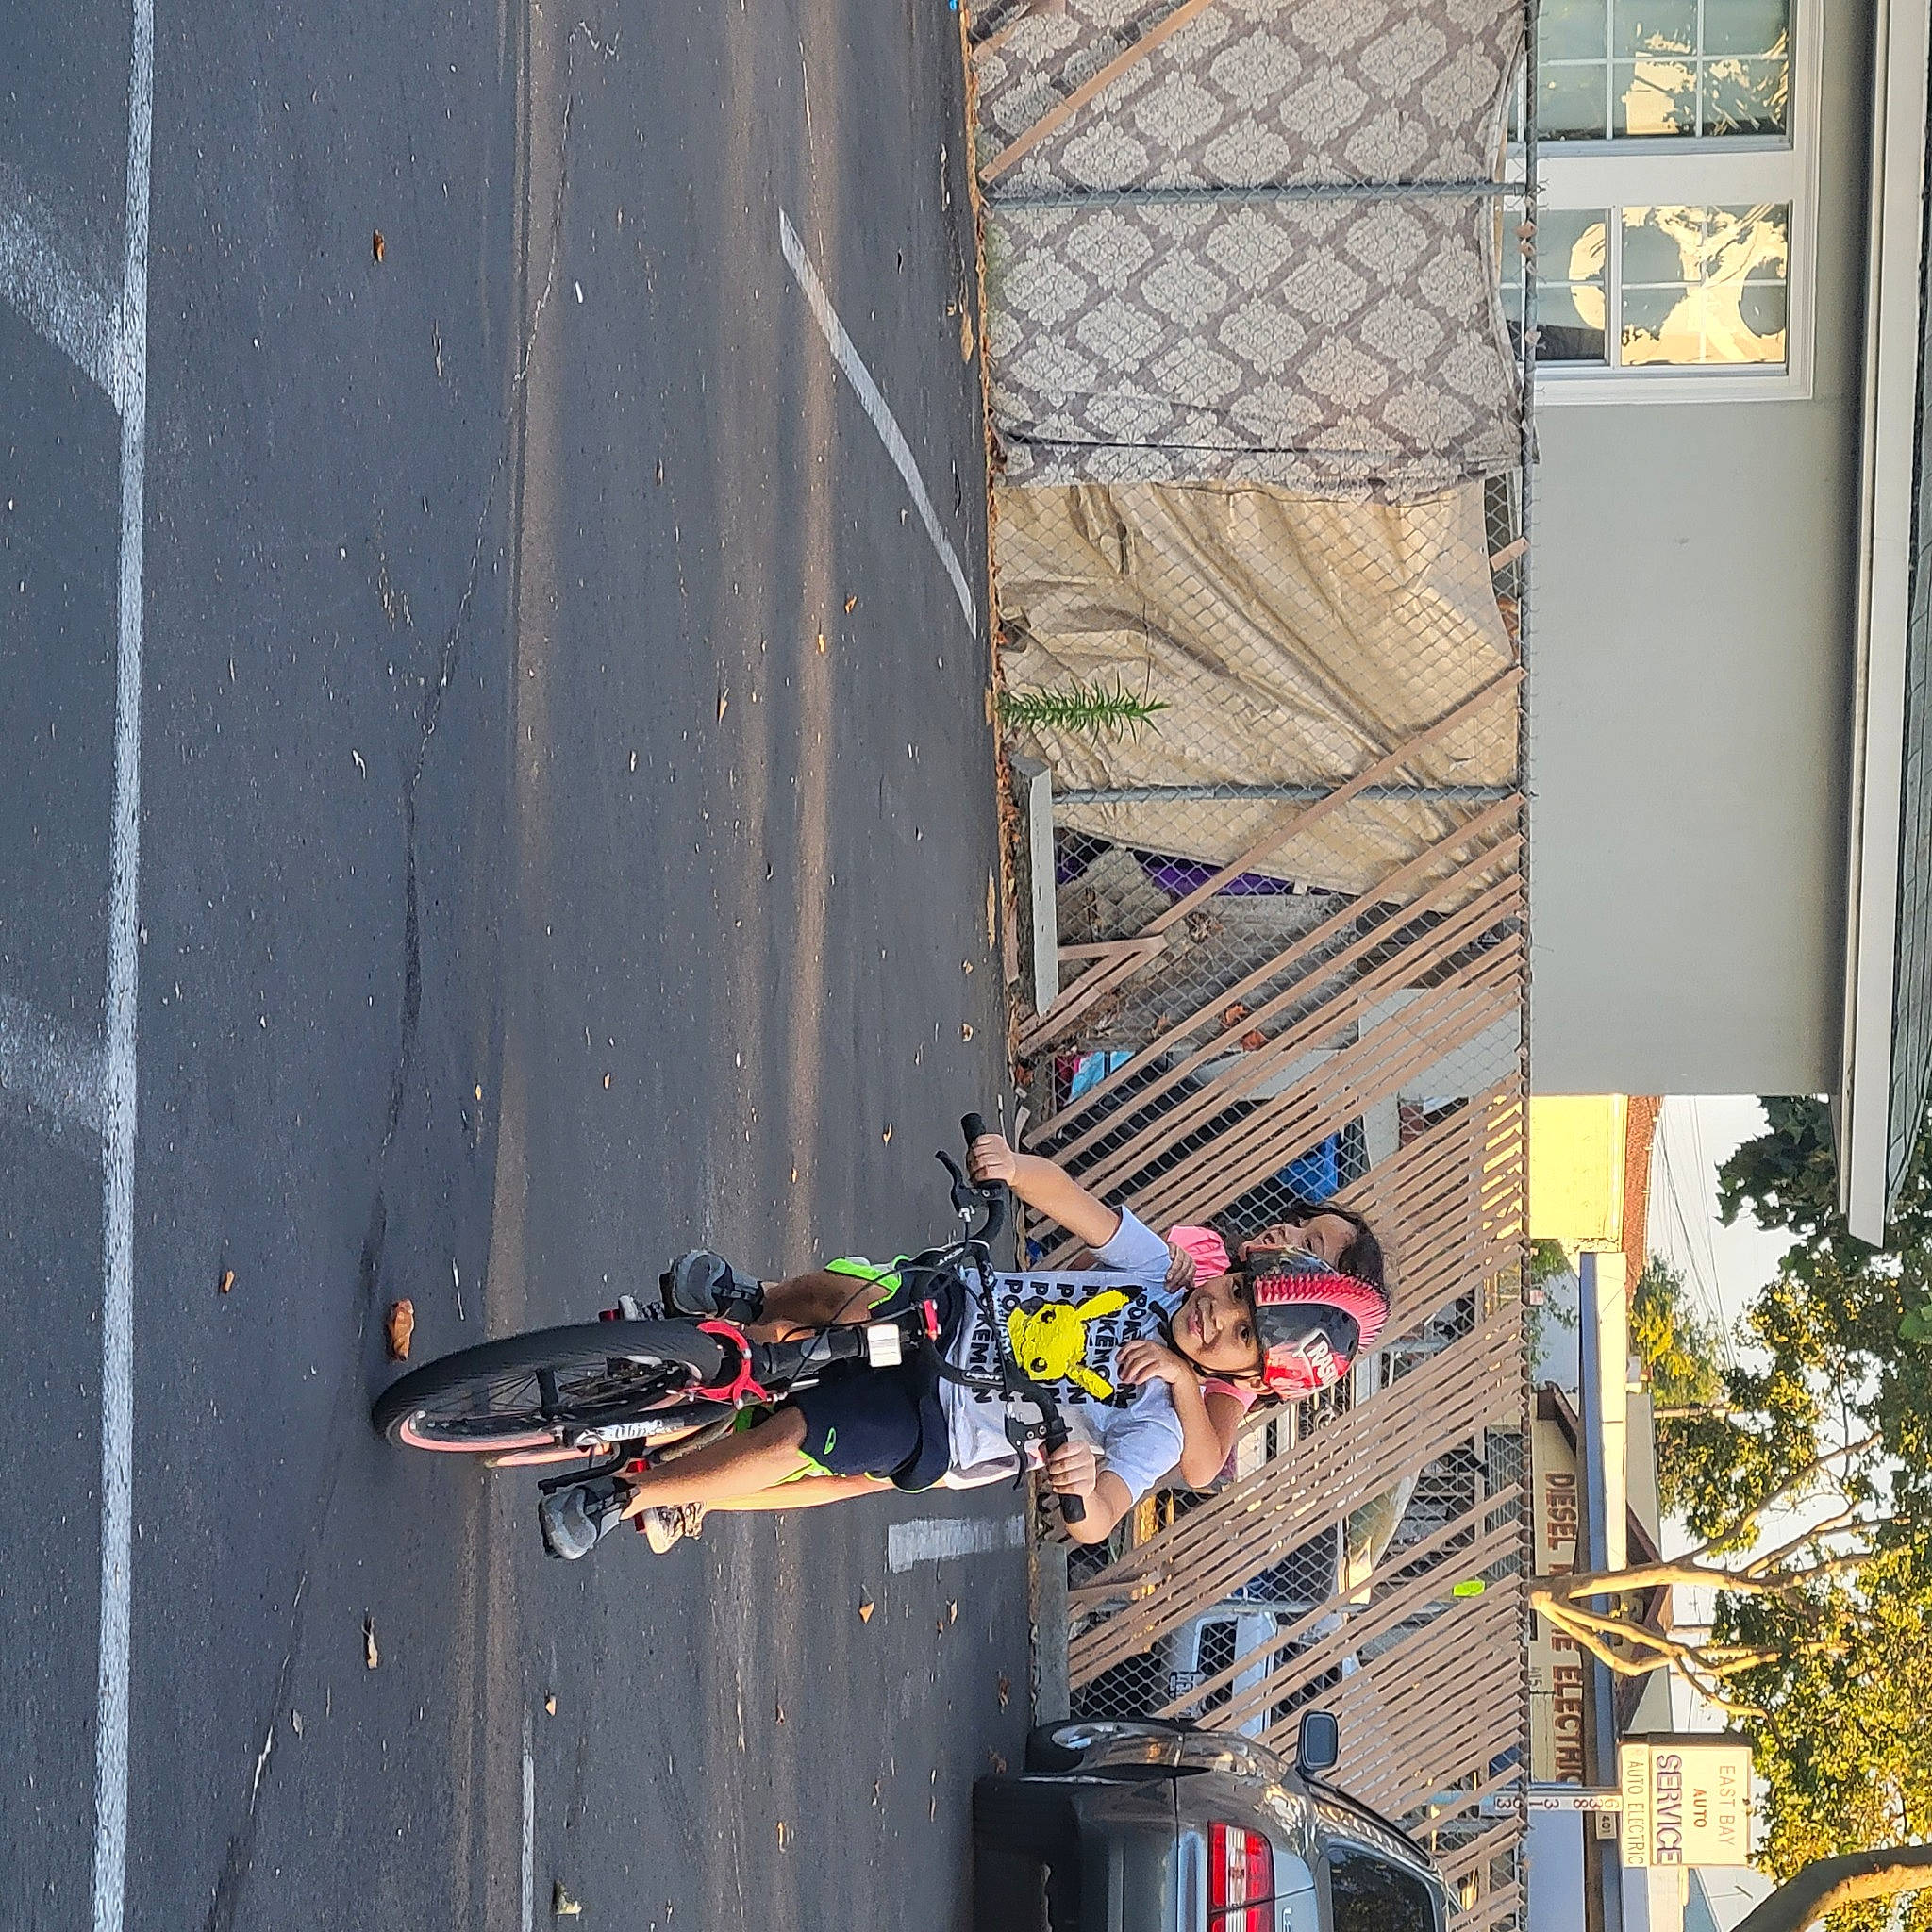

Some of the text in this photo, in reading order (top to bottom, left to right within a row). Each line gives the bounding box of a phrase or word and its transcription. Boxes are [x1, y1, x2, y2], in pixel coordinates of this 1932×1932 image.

[1545, 1473, 1577, 1551] DIESEL
[1552, 1665, 1585, 1783] ELECTRIC
[1601, 1815, 1611, 1834] 401
[1626, 1761, 1645, 1865] AUTO ELECTRIC
[1656, 1754, 1682, 1865] SERVICE
[1692, 1788, 1707, 1828] AUTO
[1719, 1765, 1736, 1846] EAST BAY
